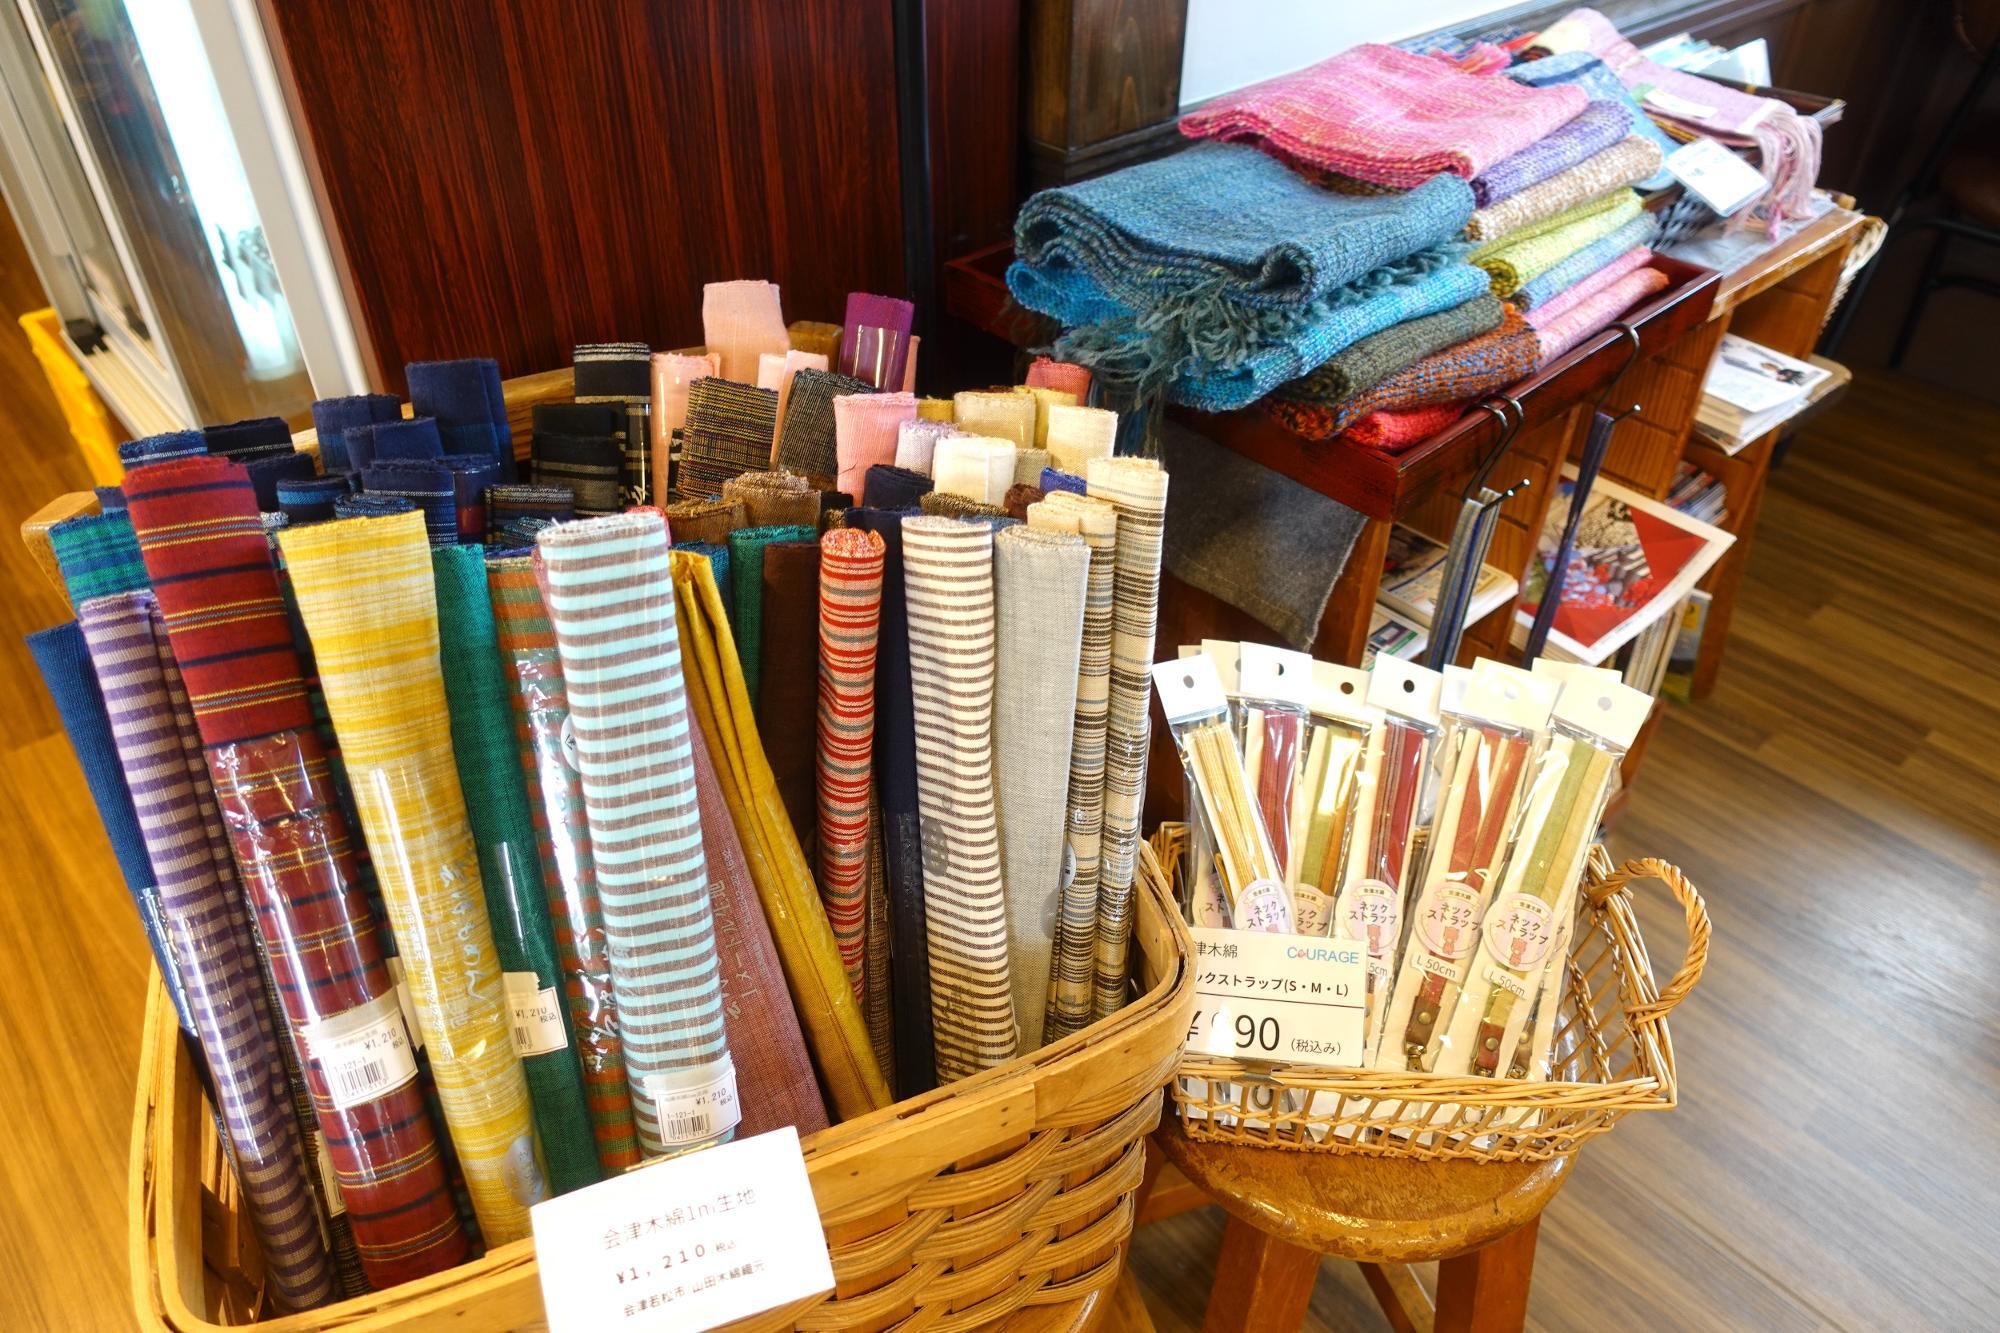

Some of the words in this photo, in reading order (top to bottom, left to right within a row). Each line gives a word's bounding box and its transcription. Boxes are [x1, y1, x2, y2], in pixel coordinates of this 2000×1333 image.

[1254, 900, 1277, 915] ネック
[1359, 901, 1388, 914] ネック
[1441, 902, 1472, 918] ネック
[1349, 910, 1397, 925] ストラップ
[1427, 909, 1480, 931] ストラップ
[1510, 913, 1541, 931] ネック
[1496, 919, 1549, 945] ストラップ
[1287, 945, 1359, 965] COURAGE
[1416, 954, 1423, 965] L
[1426, 959, 1456, 979] 50cm
[1488, 970, 1495, 982] L
[1499, 975, 1526, 996] 50cm
[1291, 1040, 1341, 1056] (税込み)
[696, 1087, 727, 1106] ¥1,210
[602, 1187, 757, 1250] 会津木綿1m生地
[623, 1284, 686, 1318] 会津若松市
[692, 1259, 767, 1293] 山田木綿織元
